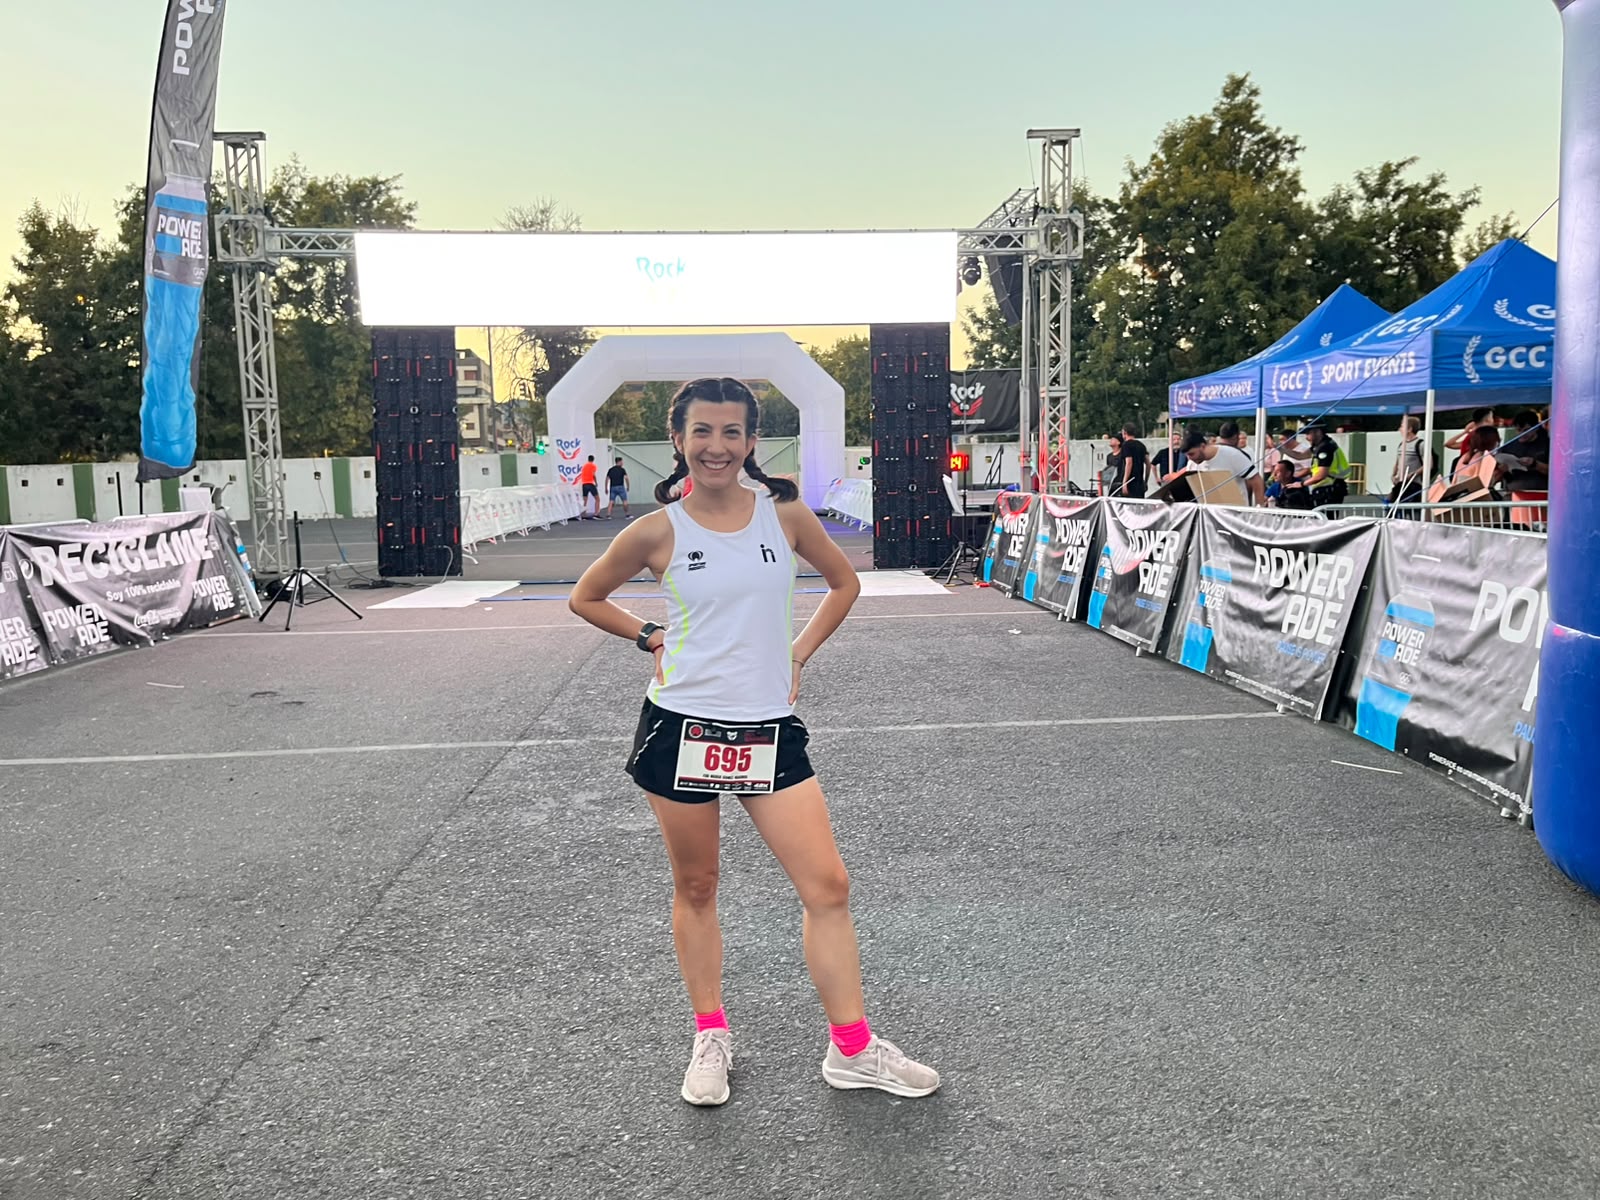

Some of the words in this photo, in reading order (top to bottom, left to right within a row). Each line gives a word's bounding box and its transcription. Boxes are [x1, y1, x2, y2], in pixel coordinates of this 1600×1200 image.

[157, 214, 202, 240] POWE
[636, 256, 686, 283] Rock
[1377, 314, 1438, 337] GCC
[1321, 358, 1361, 384] SPORT
[1363, 351, 1416, 378] EVENTS
[1484, 345, 1546, 369] GCC
[1199, 383, 1222, 401] SPORT
[1279, 370, 1304, 392] GCC
[1177, 388, 1193, 405] GCC
[556, 438, 581, 451] Rock
[558, 464, 582, 477] Rock
[1055, 518, 1090, 546] POWER
[31, 528, 214, 587] RECICLAME
[1061, 545, 1086, 572] ADE
[1125, 529, 1180, 563] POWER
[1138, 562, 1173, 598] ADE
[1252, 545, 1354, 600] POWER
[106, 590, 123, 602] Soy
[191, 575, 230, 599] POWER
[212, 591, 236, 612] ADE
[1469, 579, 1548, 648] PO
[42, 603, 106, 633] POWER
[1281, 594, 1344, 646] ADE
[76, 621, 110, 647] ADE
[1382, 621, 1425, 648] POWER
[2, 637, 36, 666] ADE
[1393, 646, 1421, 666] ADE
[1513, 720, 1535, 744] PAU
[704, 745, 752, 773] 695
